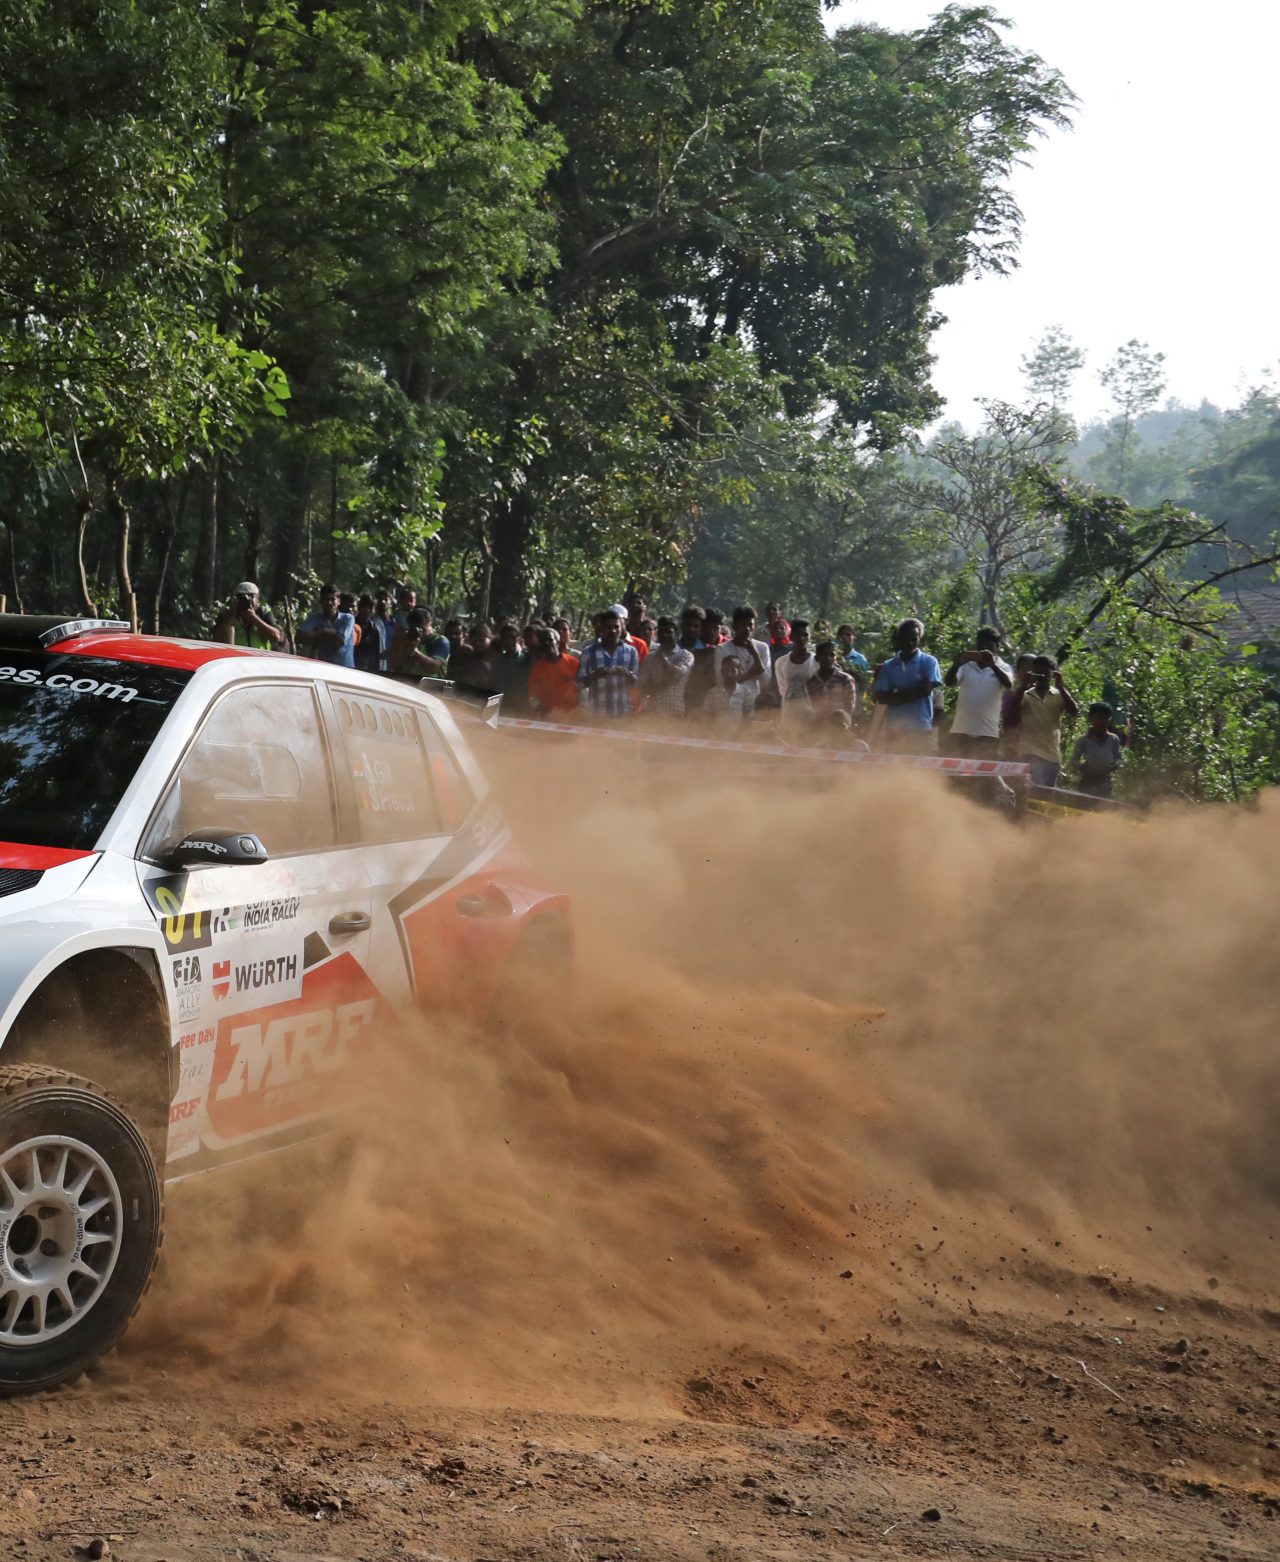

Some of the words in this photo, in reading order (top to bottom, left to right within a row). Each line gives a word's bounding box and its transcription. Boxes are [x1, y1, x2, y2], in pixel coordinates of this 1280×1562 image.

[180, 841, 228, 856] MRF
[243, 907, 270, 928] INDIA
[271, 902, 300, 922] RALLY
[216, 998, 377, 1101] MRF
[70, 1217, 84, 1264] speedline
